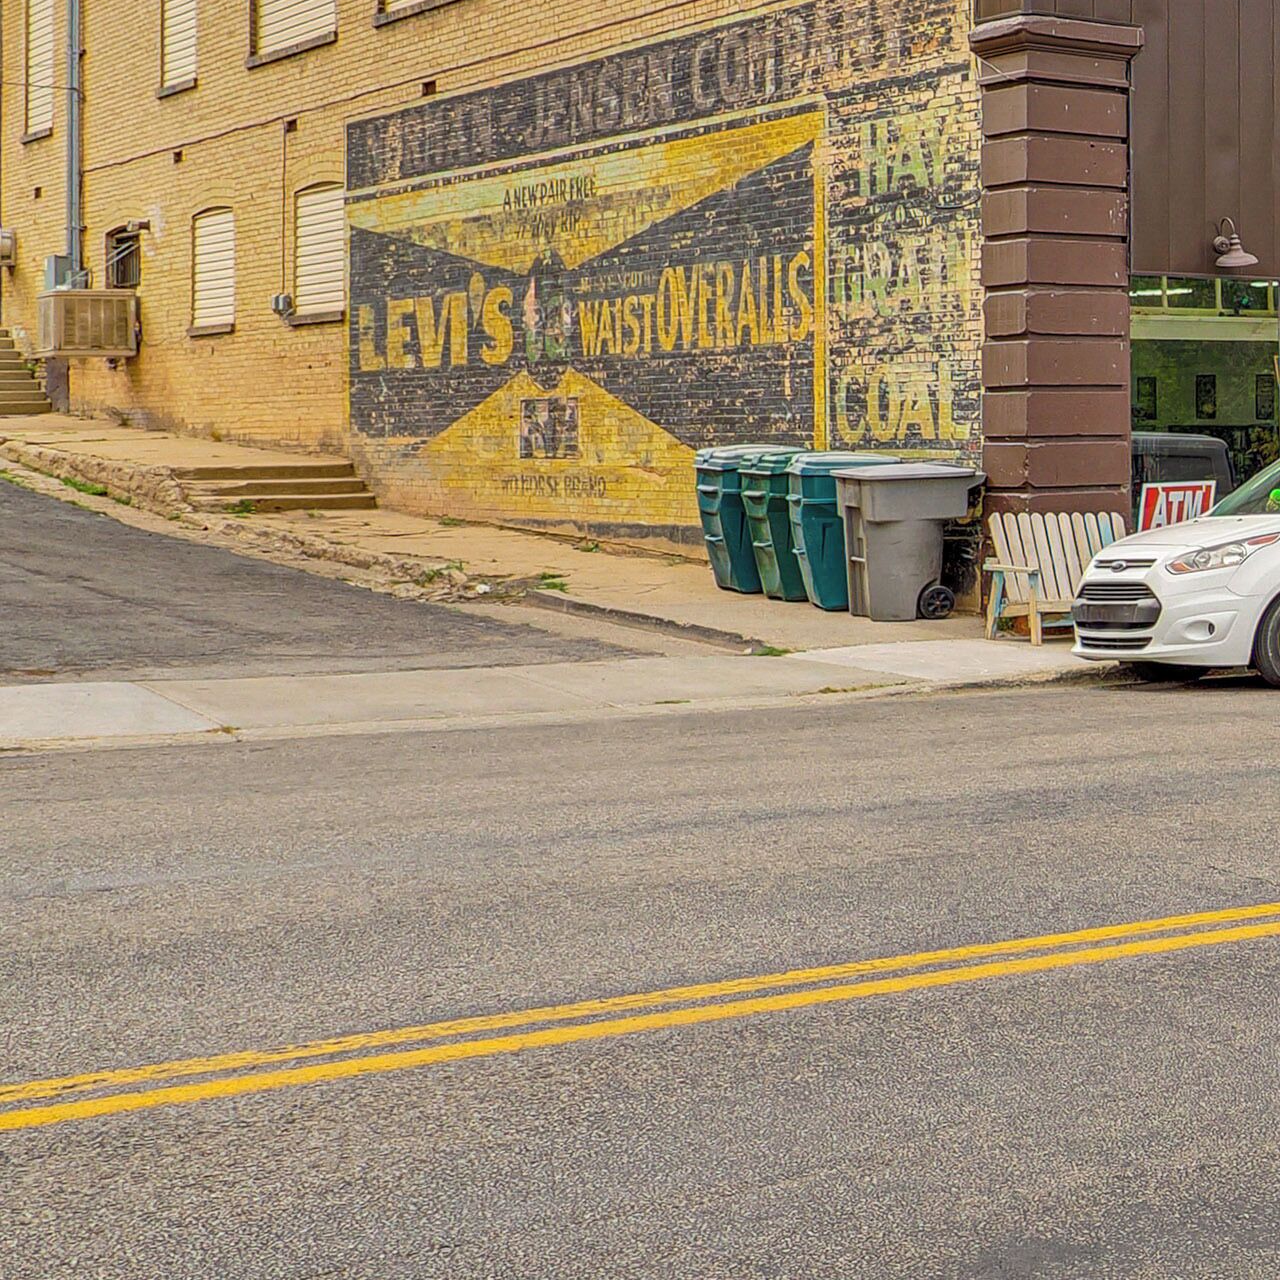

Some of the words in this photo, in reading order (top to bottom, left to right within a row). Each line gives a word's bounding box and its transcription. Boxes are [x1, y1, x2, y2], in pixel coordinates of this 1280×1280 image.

[503, 188, 512, 211] A
[514, 182, 538, 208] NEW
[539, 177, 567, 203] PAIR
[569, 174, 597, 200] FREE
[856, 113, 955, 197] HAY
[358, 271, 514, 370] LEVI'S
[578, 294, 656, 357] WAIST
[656, 251, 814, 352] OVERALLS
[835, 361, 972, 442] COAL
[1150, 490, 1204, 528] ATM
